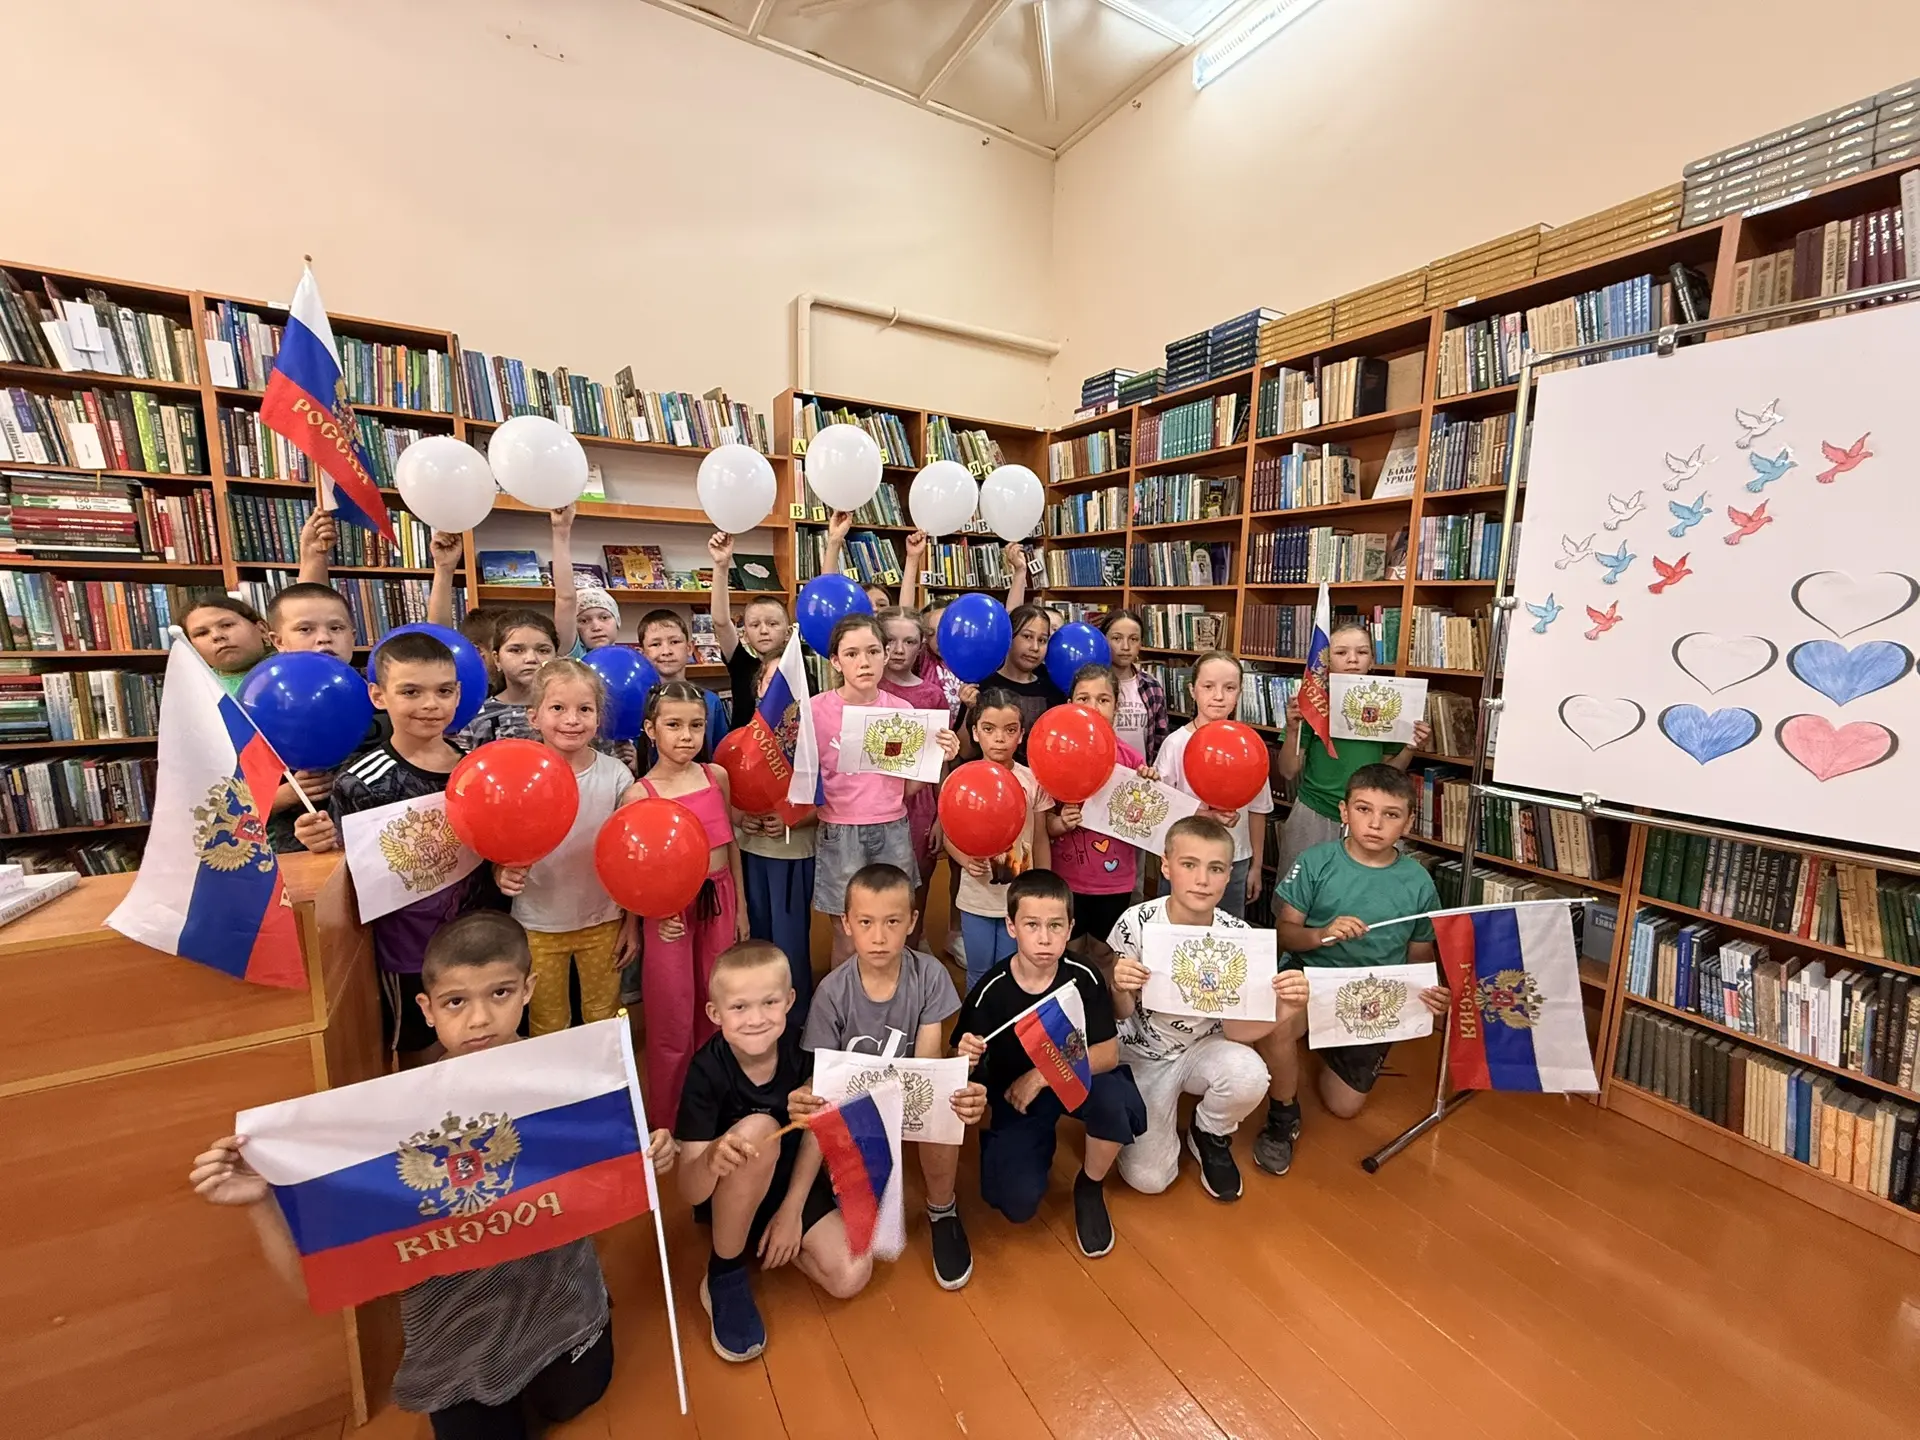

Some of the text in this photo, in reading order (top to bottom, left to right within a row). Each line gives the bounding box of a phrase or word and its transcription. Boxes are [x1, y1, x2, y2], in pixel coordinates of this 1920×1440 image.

[291, 398, 369, 485] РОССИЯ
[794, 441, 805, 453] А
[970, 463, 980, 475] Я
[793, 505, 803, 517] В
[813, 508, 823, 520] Г
[978, 520, 988, 533] В
[888, 571, 896, 582] З
[923, 572, 930, 583] З
[935, 574, 943, 585] К
[745, 718, 789, 781] РОССИЯ
[1041, 1040, 1074, 1083] РОССИЯ
